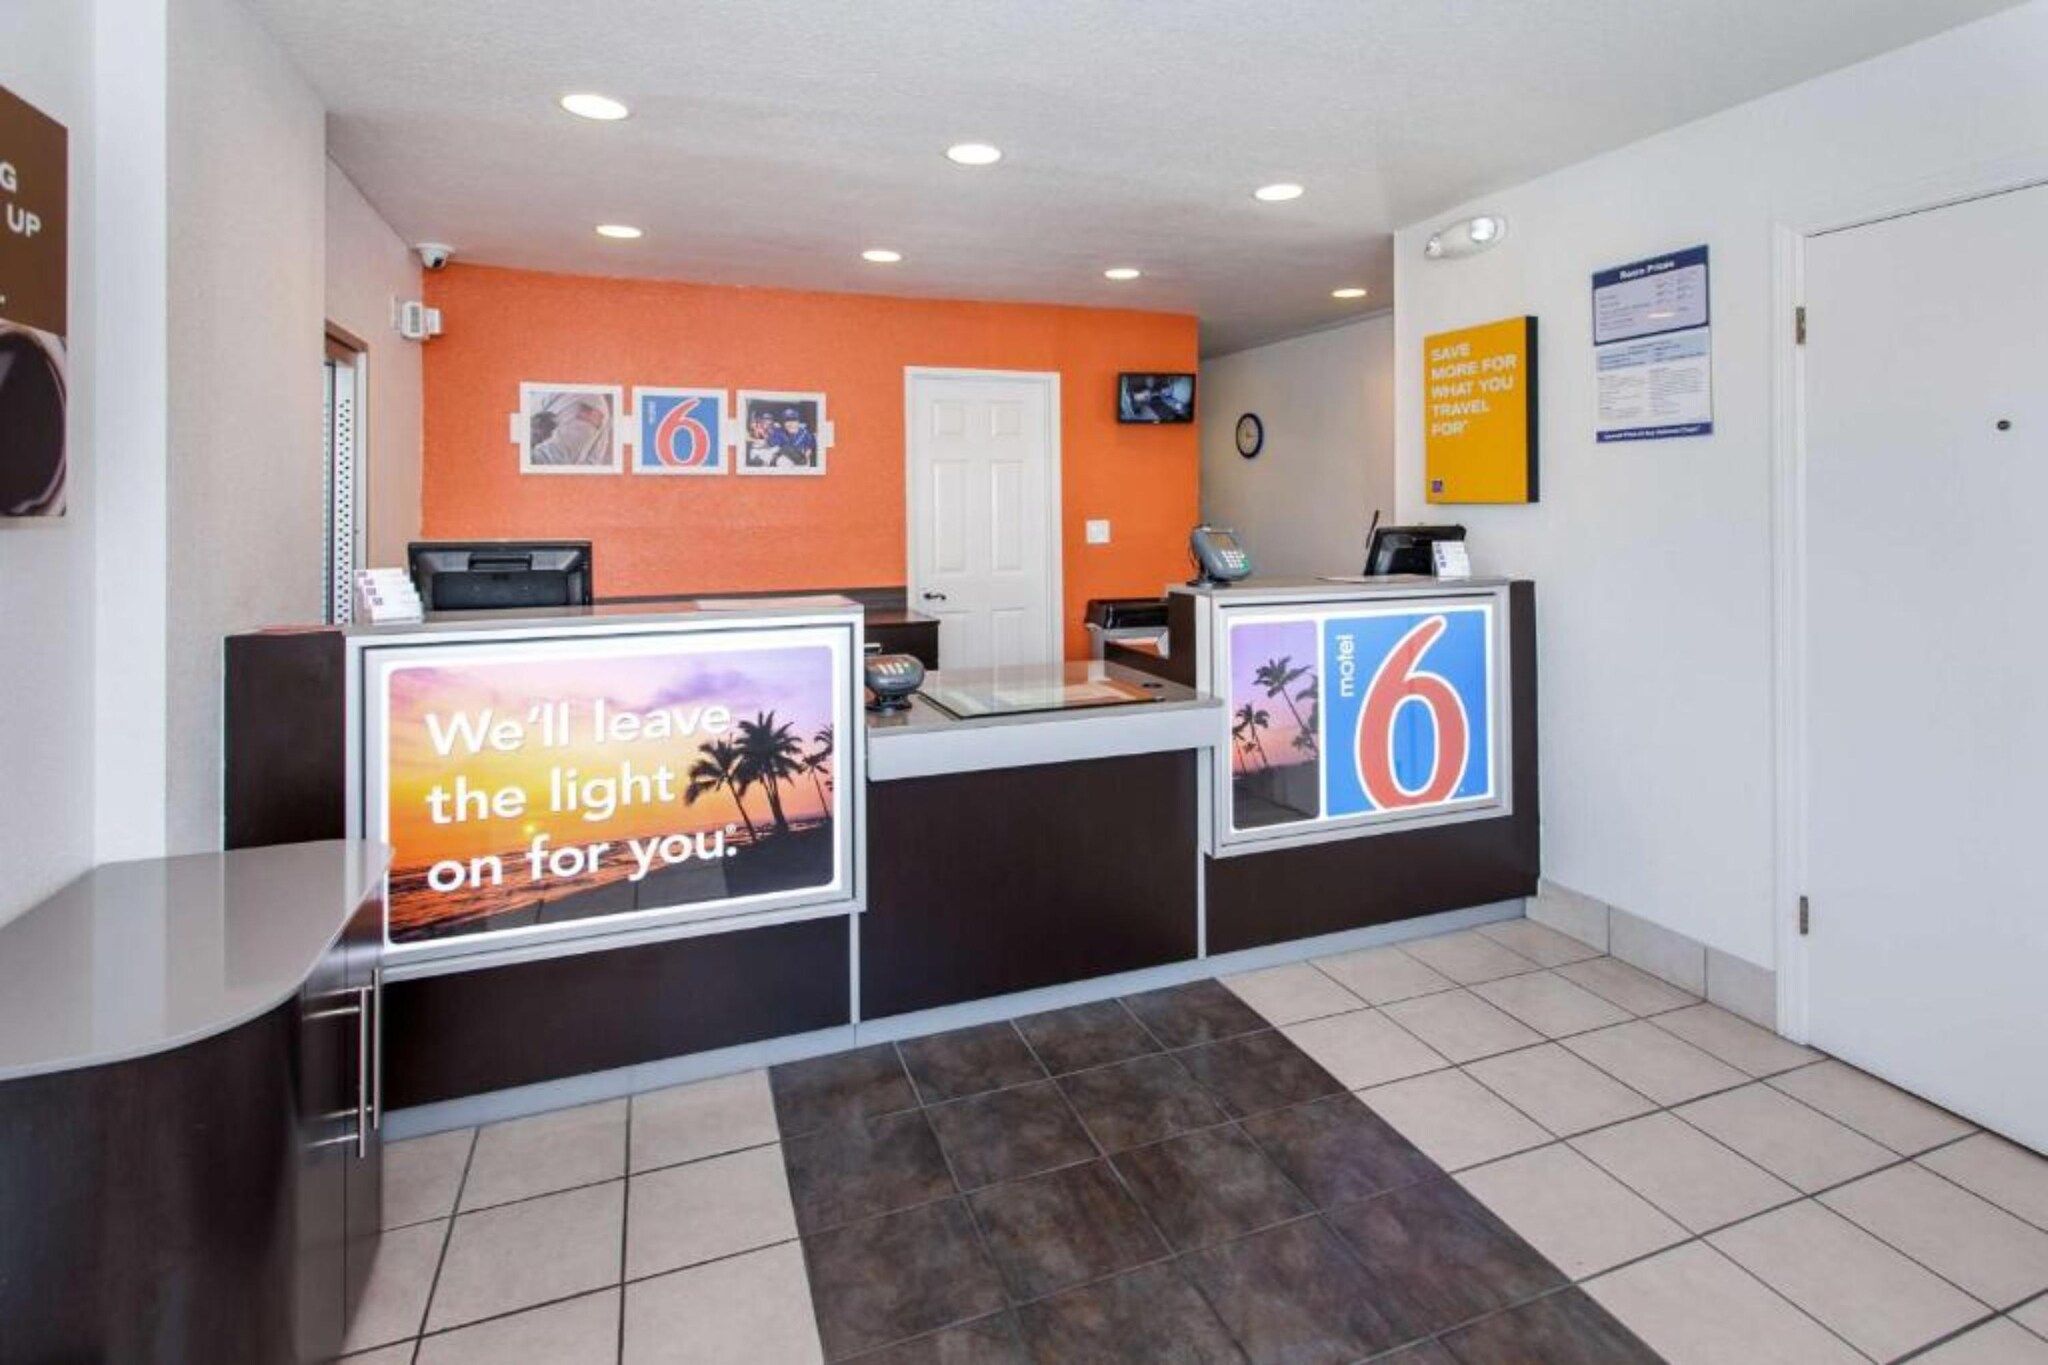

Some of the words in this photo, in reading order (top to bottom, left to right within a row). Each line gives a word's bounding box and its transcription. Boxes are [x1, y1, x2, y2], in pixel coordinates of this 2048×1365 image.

[6, 202, 42, 238] UP
[1431, 342, 1470, 361] SAVE
[1431, 361, 1479, 380] MORE
[1482, 353, 1517, 372] FOR
[1431, 381, 1473, 400] WHAT
[1479, 375, 1514, 394] YOU
[1432, 399, 1490, 418] TRAVEL
[656, 397, 711, 469] 6
[425, 700, 571, 757] We'll
[594, 698, 732, 744] leave
[1335, 633, 1356, 698] motel
[1353, 614, 1471, 812] 6
[425, 776, 528, 825] the
[549, 759, 677, 823] light
[426, 853, 503, 892] on
[525, 832, 612, 881] for
